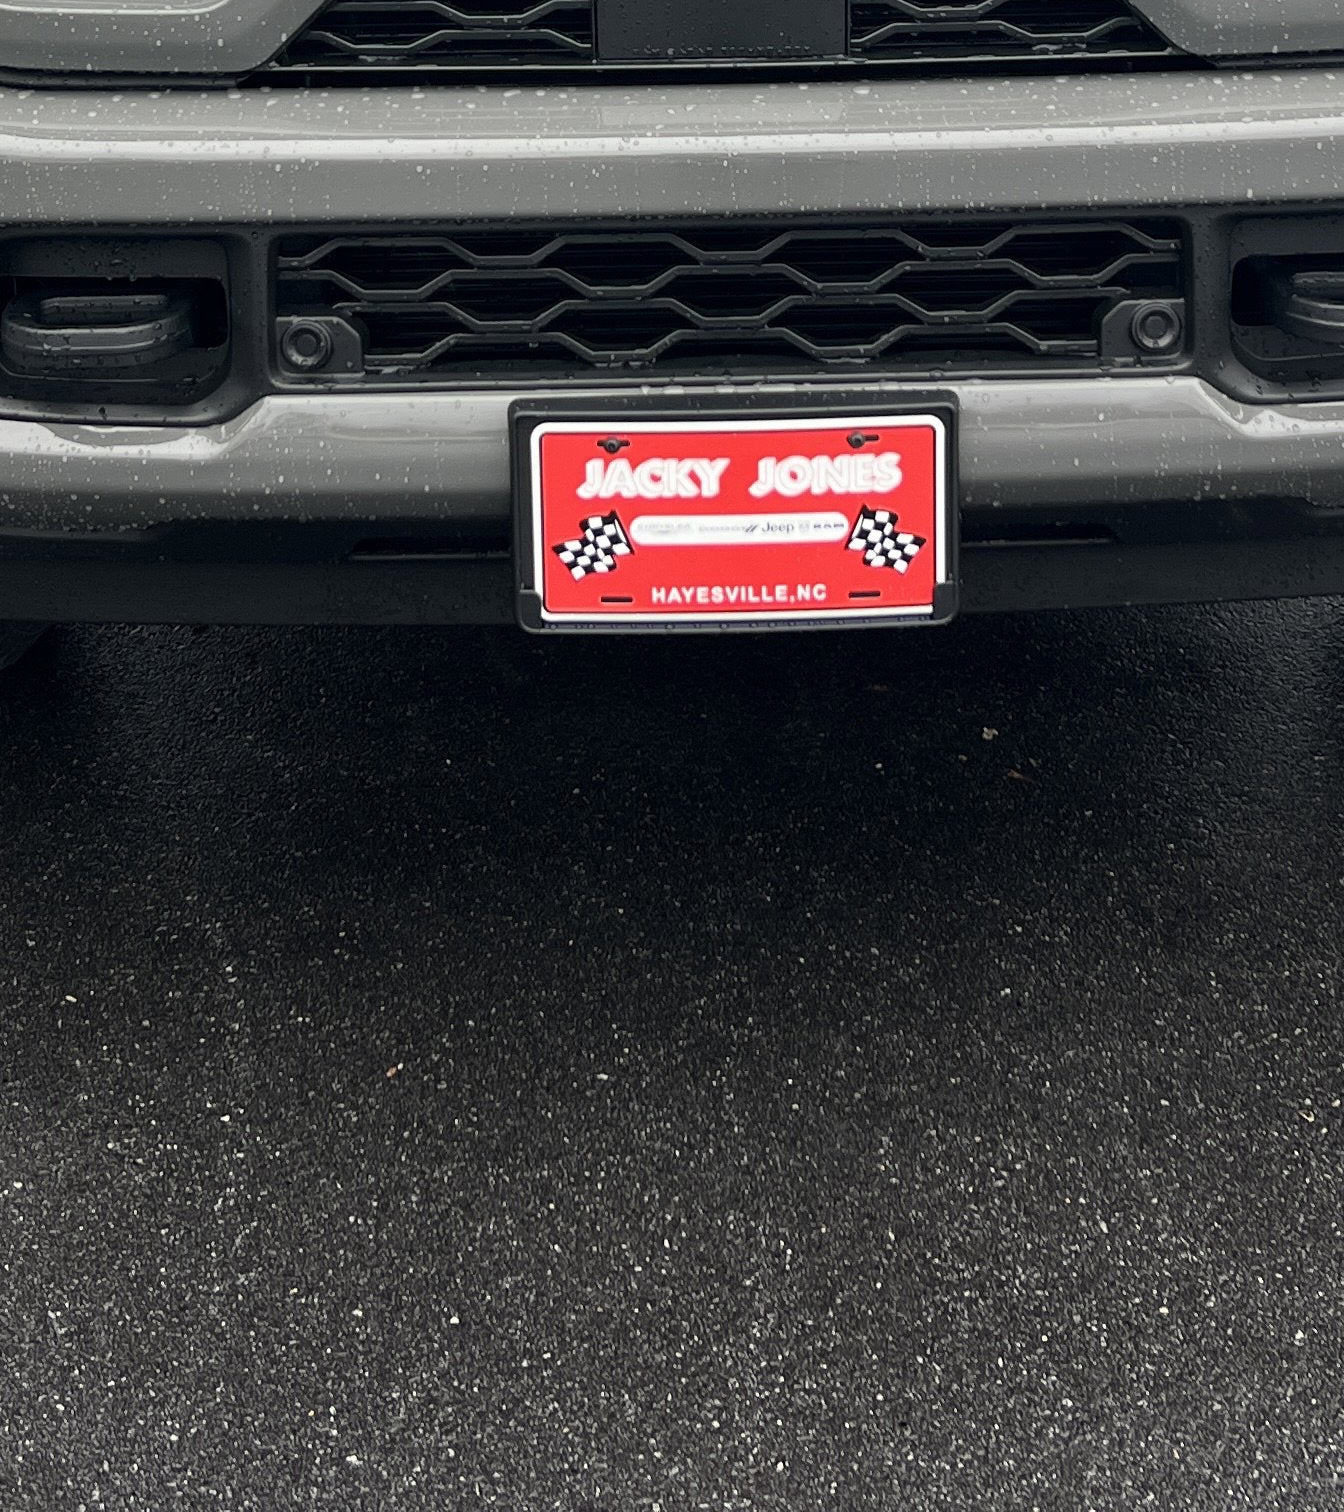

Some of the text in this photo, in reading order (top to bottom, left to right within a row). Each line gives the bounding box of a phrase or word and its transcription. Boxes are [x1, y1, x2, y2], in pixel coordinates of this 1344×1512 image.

[577, 453, 902, 498] JACKY JONES
[761, 517, 794, 533] Jeep
